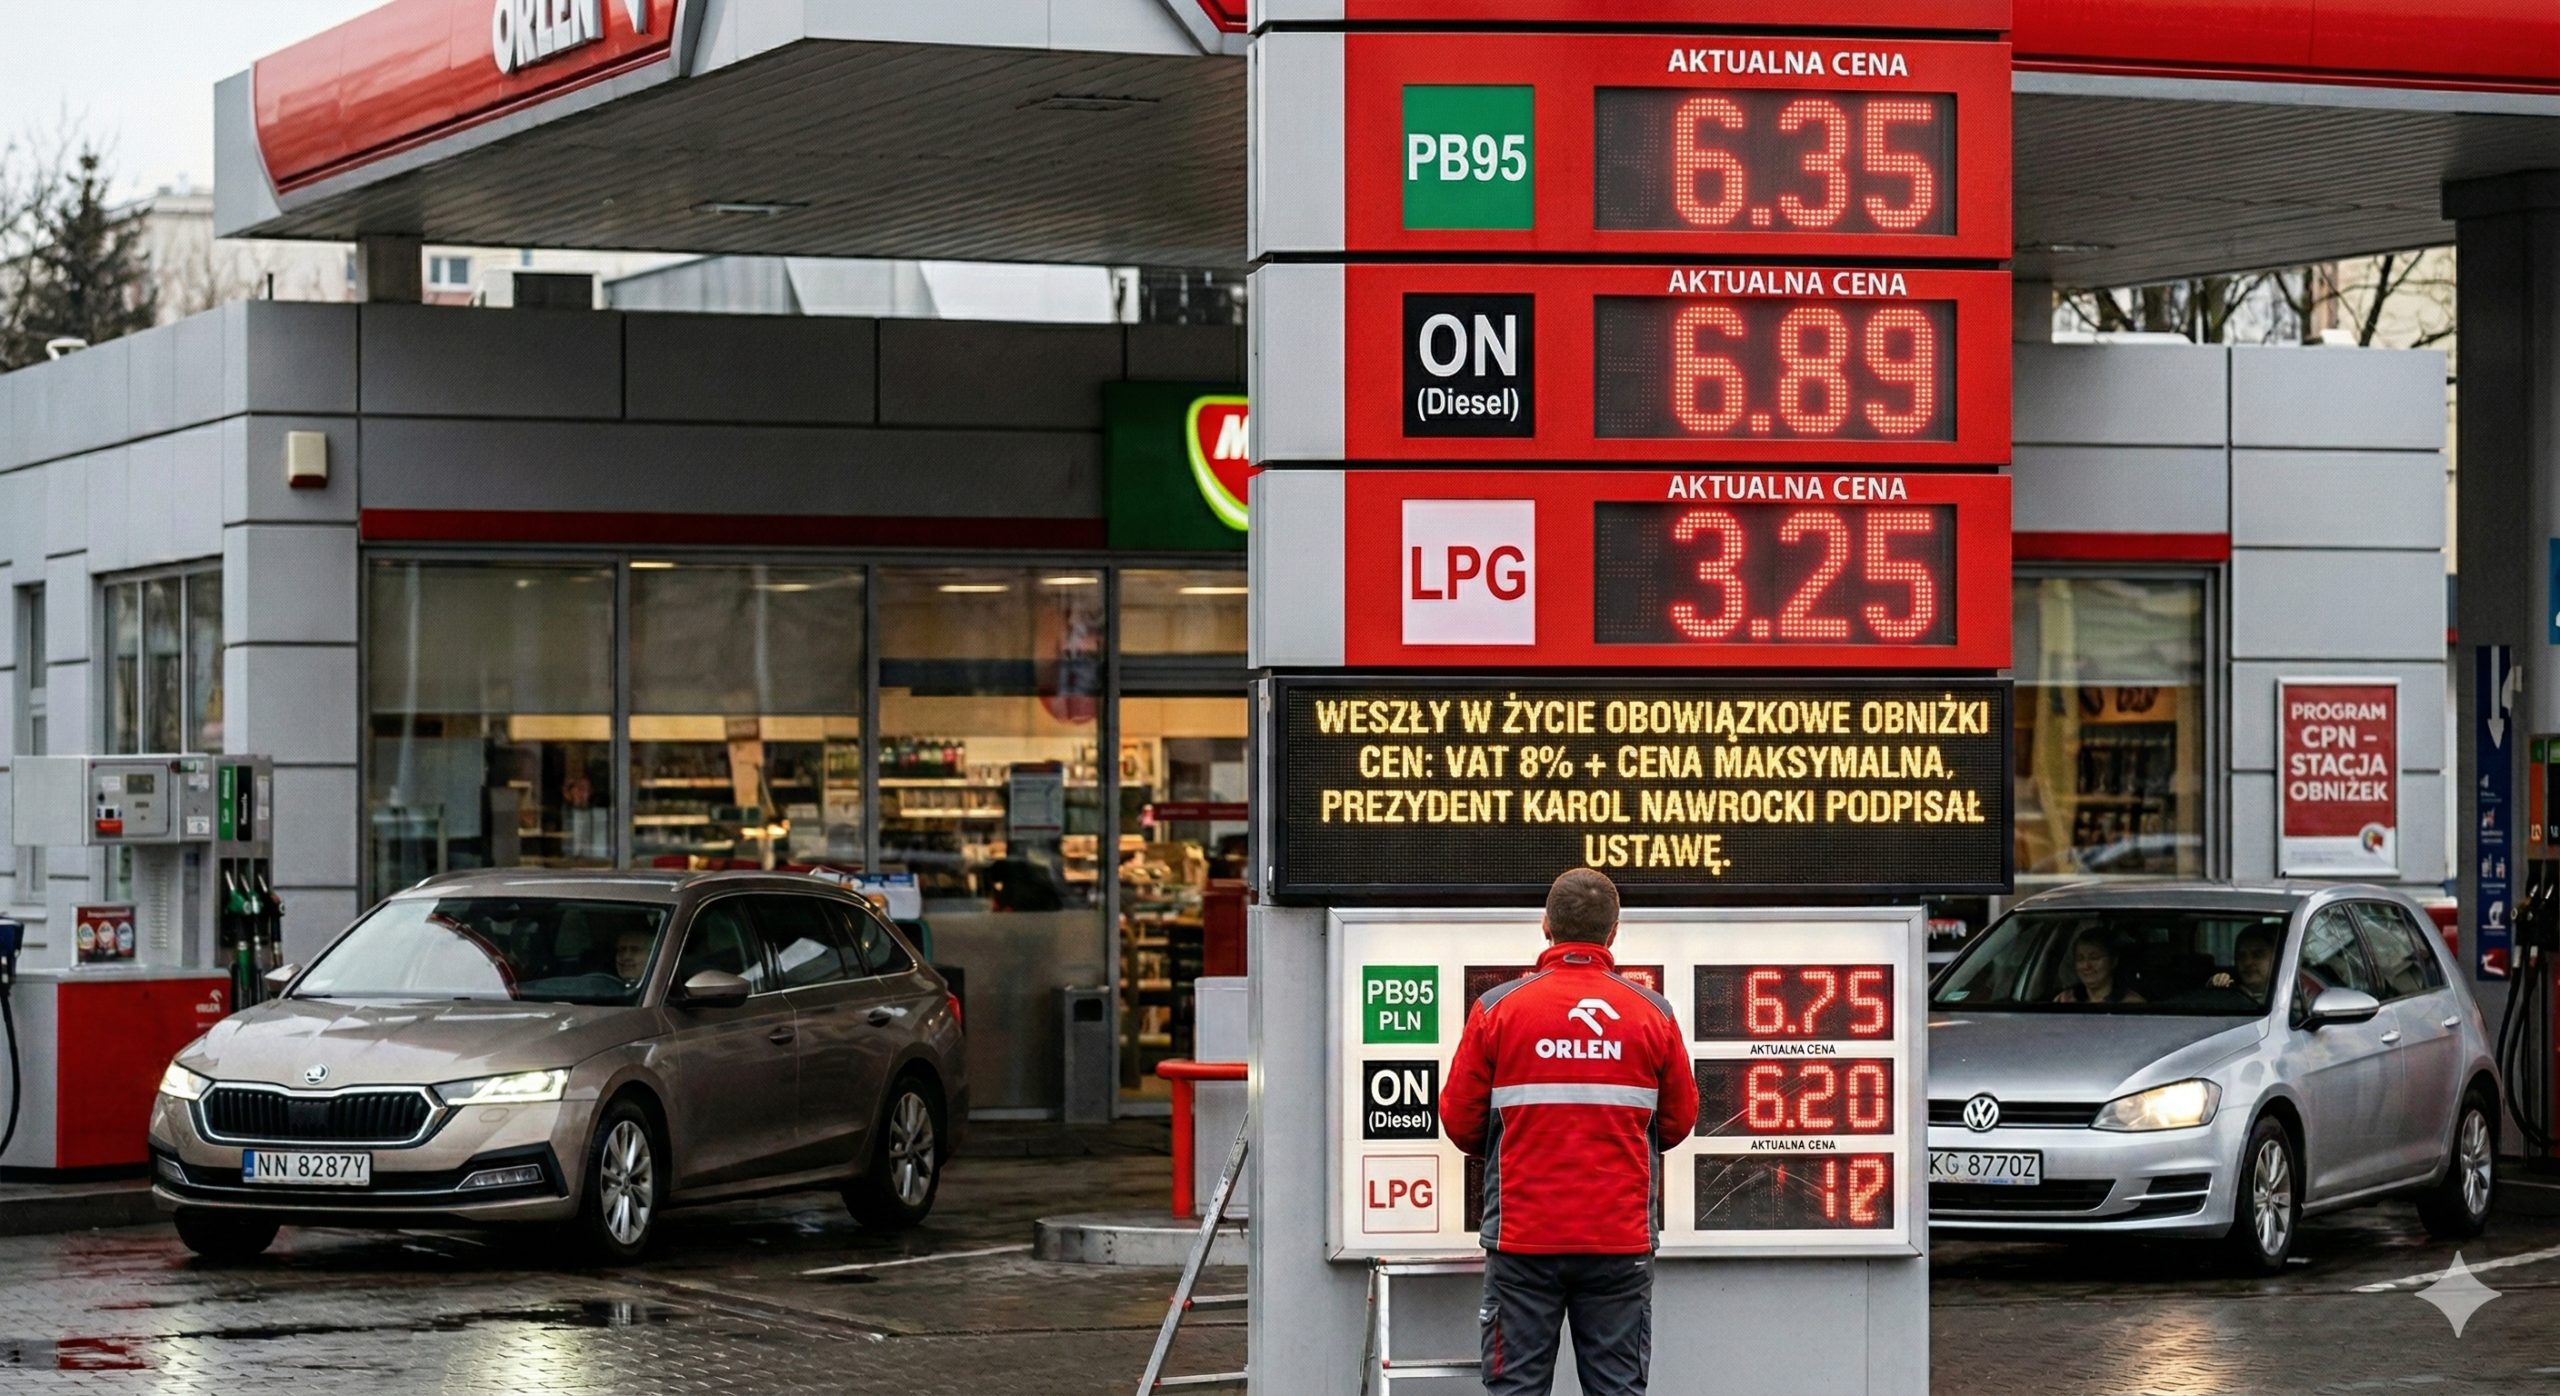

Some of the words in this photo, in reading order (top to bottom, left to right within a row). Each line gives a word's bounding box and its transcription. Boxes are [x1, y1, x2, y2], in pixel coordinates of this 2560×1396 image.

[1669, 49, 1822, 76] AKTUALNA
[1832, 51, 1908, 76] CENA
[1407, 134, 1527, 182] PB95
[1674, 97, 1934, 229] 6.35
[1668, 270, 1823, 295] AKTUALNA
[1832, 271, 1907, 296] CENA
[1419, 314, 1517, 377] ON
[1674, 304, 1936, 434] 6.89
[1417, 387, 1519, 422] (Diesel)
[1667, 476, 1825, 500] AKTUALNA
[1833, 477, 1908, 500] CENA
[1411, 546, 1527, 601] LPG
[1671, 510, 1936, 640] 3.25
[1316, 700, 1450, 734] WESZŁY
[1460, 700, 1493, 734] W
[1502, 692, 1595, 734] ŻYCIE
[1606, 700, 1851, 743] OBOWIĄZKOWE
[1862, 693, 1989, 734] OBNIŻKI
[2291, 702, 2387, 721] PROGRAM
[2301, 724, 2356, 749] CPN
[1359, 745, 1433, 779] CEN:
[1445, 745, 1510, 779] VAT
[1519, 745, 1574, 779] 8%
[1584, 753, 1607, 778] +
[1617, 744, 1702, 779] CENA
[1713, 744, 1954, 781] MAKSYMALNA,
[2291, 752, 2388, 777] STACJA
[2290, 776, 2388, 801] OBNIŻEK
[1321, 789, 1514, 823] PREZYDENT
[1522, 789, 1631, 823] KAROL
[1640, 789, 1815, 823] NAWROCKI
[1825, 789, 1985, 823] PODPISAŁ
[1584, 834, 1732, 876] USTAWĘ.
[1367, 979, 1434, 1005] PB95
[1748, 970, 1886, 1034] 6.75
[1379, 1011, 1421, 1031] PLN
[1536, 1038, 1622, 1060] ORLEN
[1750, 1044, 1804, 1055] AKTUALNA
[1807, 1044, 1836, 1055] CENA
[1371, 1069, 1429, 1106] ON
[1748, 1065, 1885, 1129] 6.20
[1368, 1110, 1432, 1133] (Diesel)
[1750, 1140, 1804, 1150] AKTUALNA
[1807, 1140, 1836, 1150] CENA
[258, 1154, 288, 1177] NN
[298, 1155, 365, 1178] 8287Y
[1967, 1154, 2037, 1178] 8770Z
[1369, 1179, 1433, 1209] LPG
